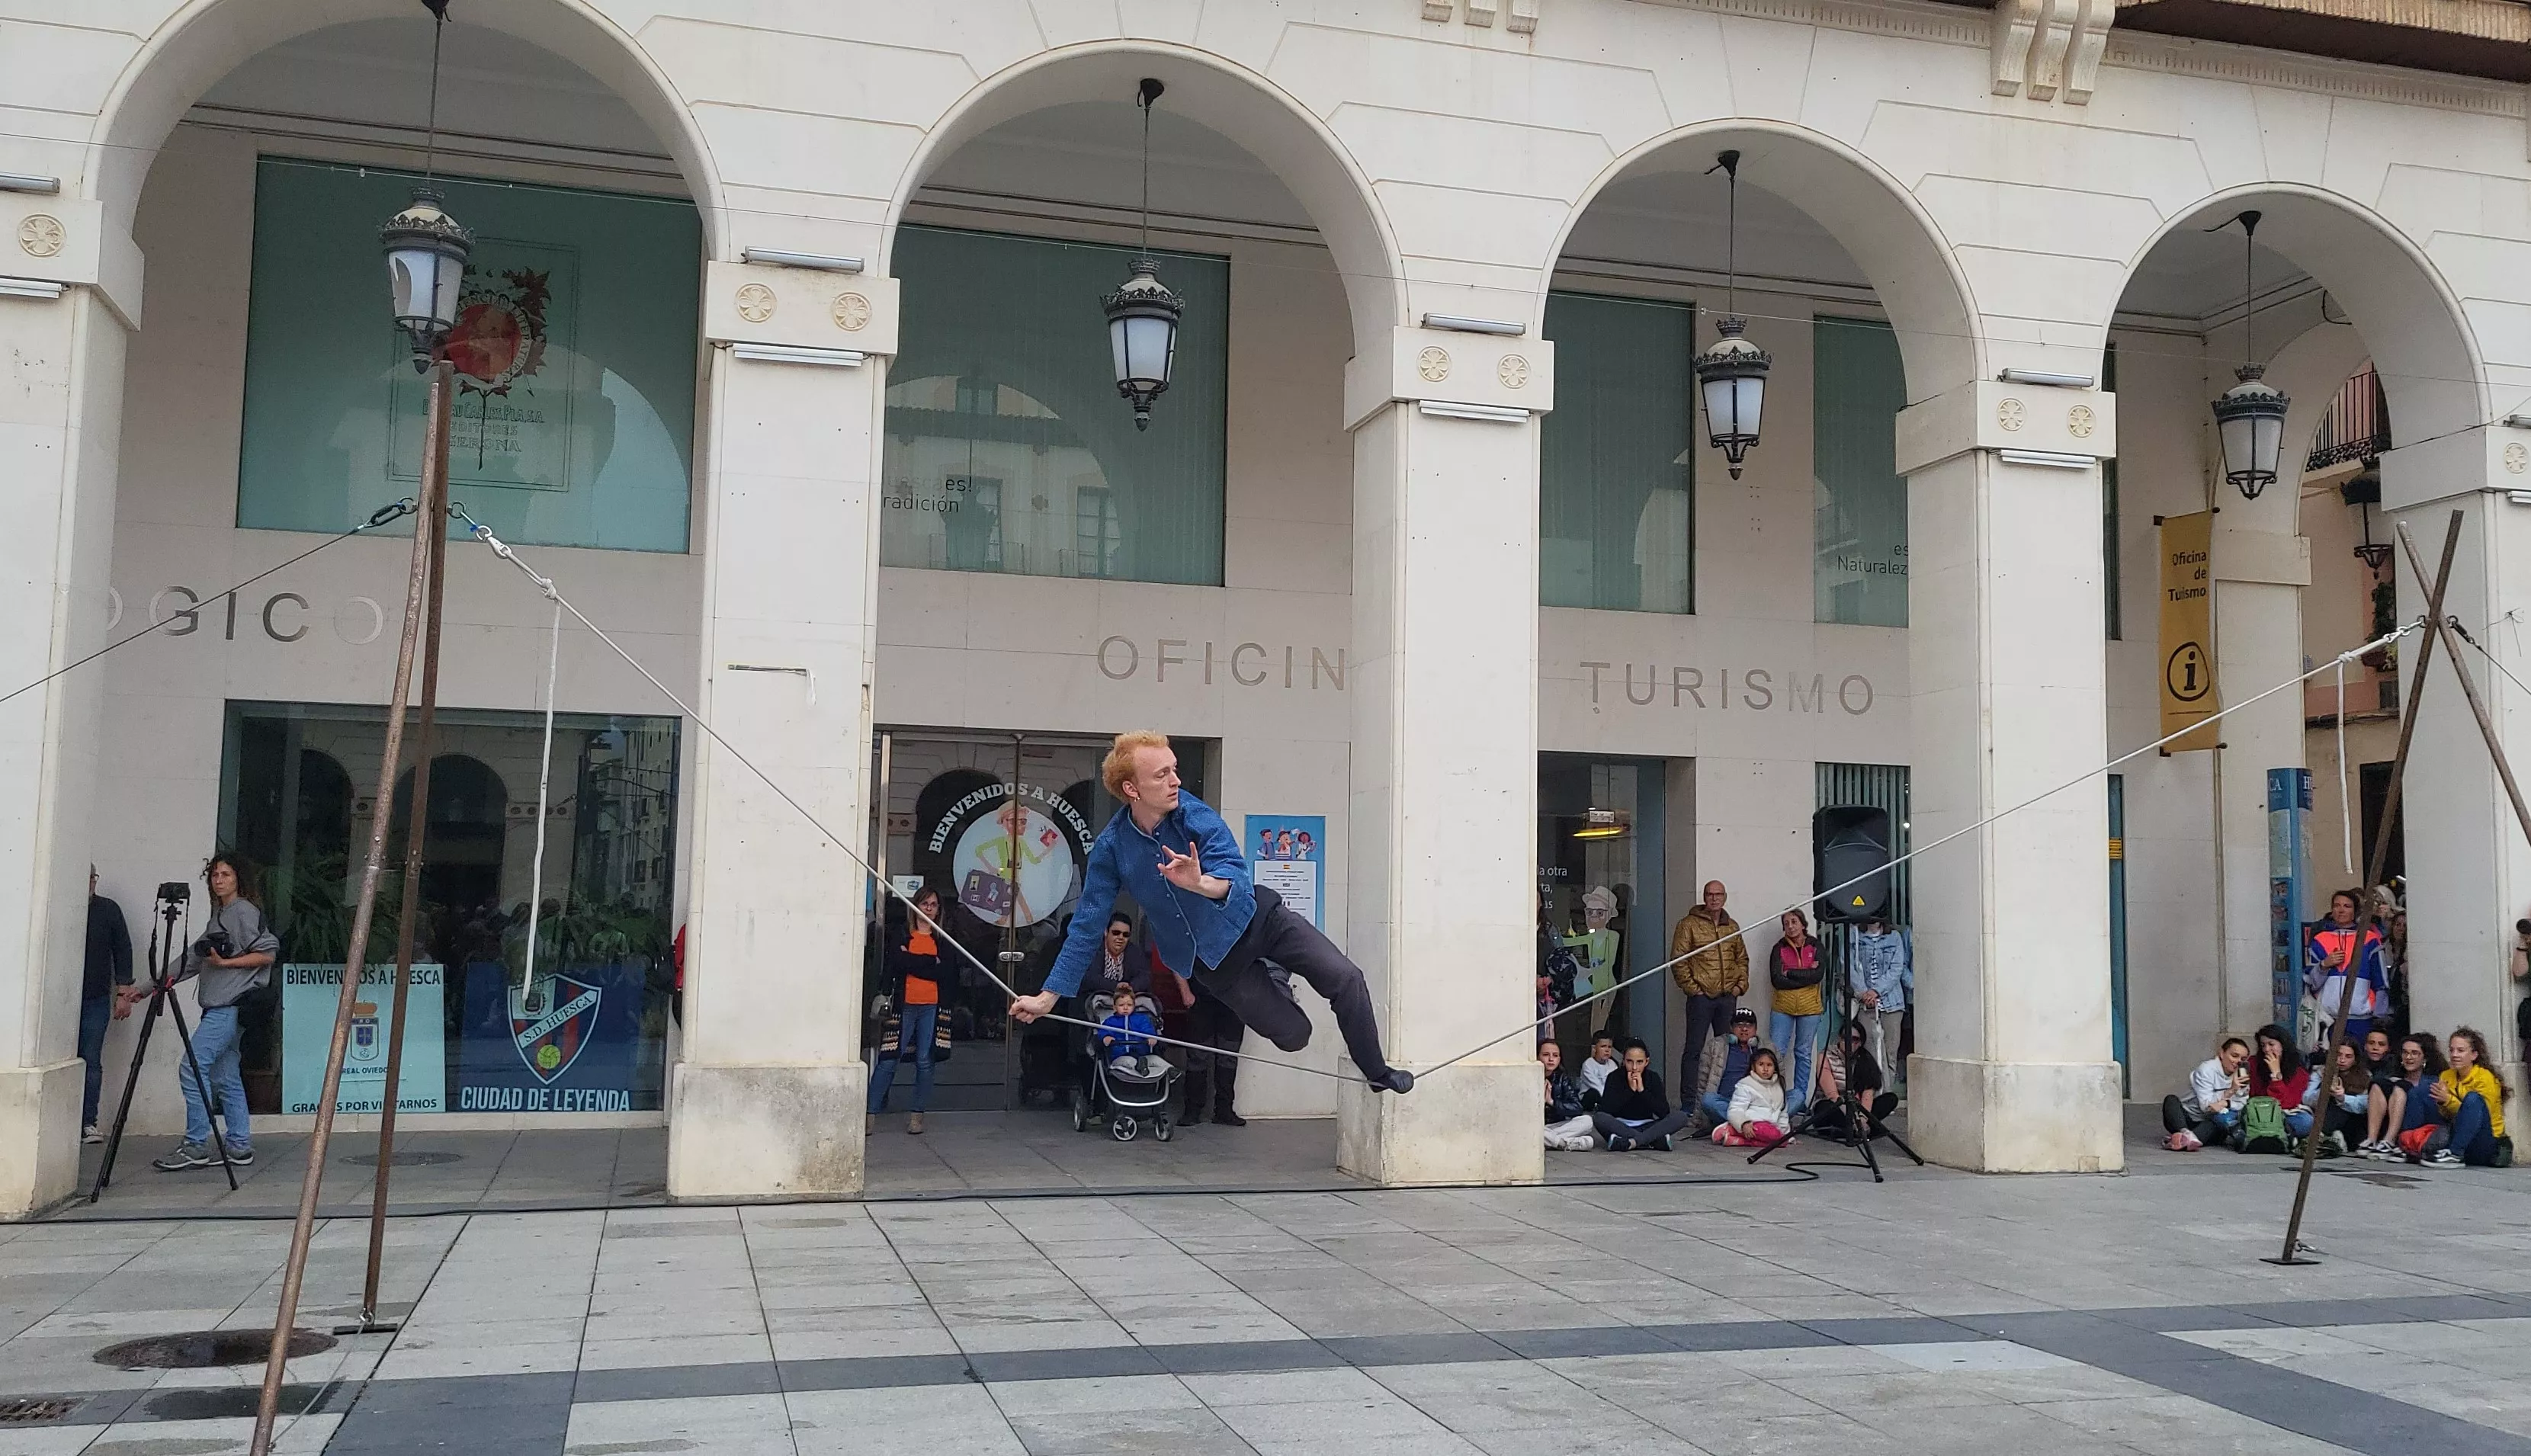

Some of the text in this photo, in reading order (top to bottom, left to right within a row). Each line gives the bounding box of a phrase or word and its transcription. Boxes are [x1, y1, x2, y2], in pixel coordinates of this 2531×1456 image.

[945, 476, 972, 492] es!
[884, 492, 959, 513] radición
[1837, 555, 1907, 576] Naturalez
[2172, 550, 2207, 566] Oficina
[2194, 566, 2207, 580] de
[1097, 635, 1874, 715] OFICIN TURISMO
[928, 782, 1095, 855] BIENVENIDOS A HUESCA
[1548, 865, 1567, 877] otra
[287, 969, 441, 985] BIENVENOS A HESCA
[524, 996, 593, 1043] S.D. HUESCA
[292, 1098, 438, 1113] GRAS POR VIARNOS
[460, 1086, 630, 1111] CIUDAD DE LEYENDA
